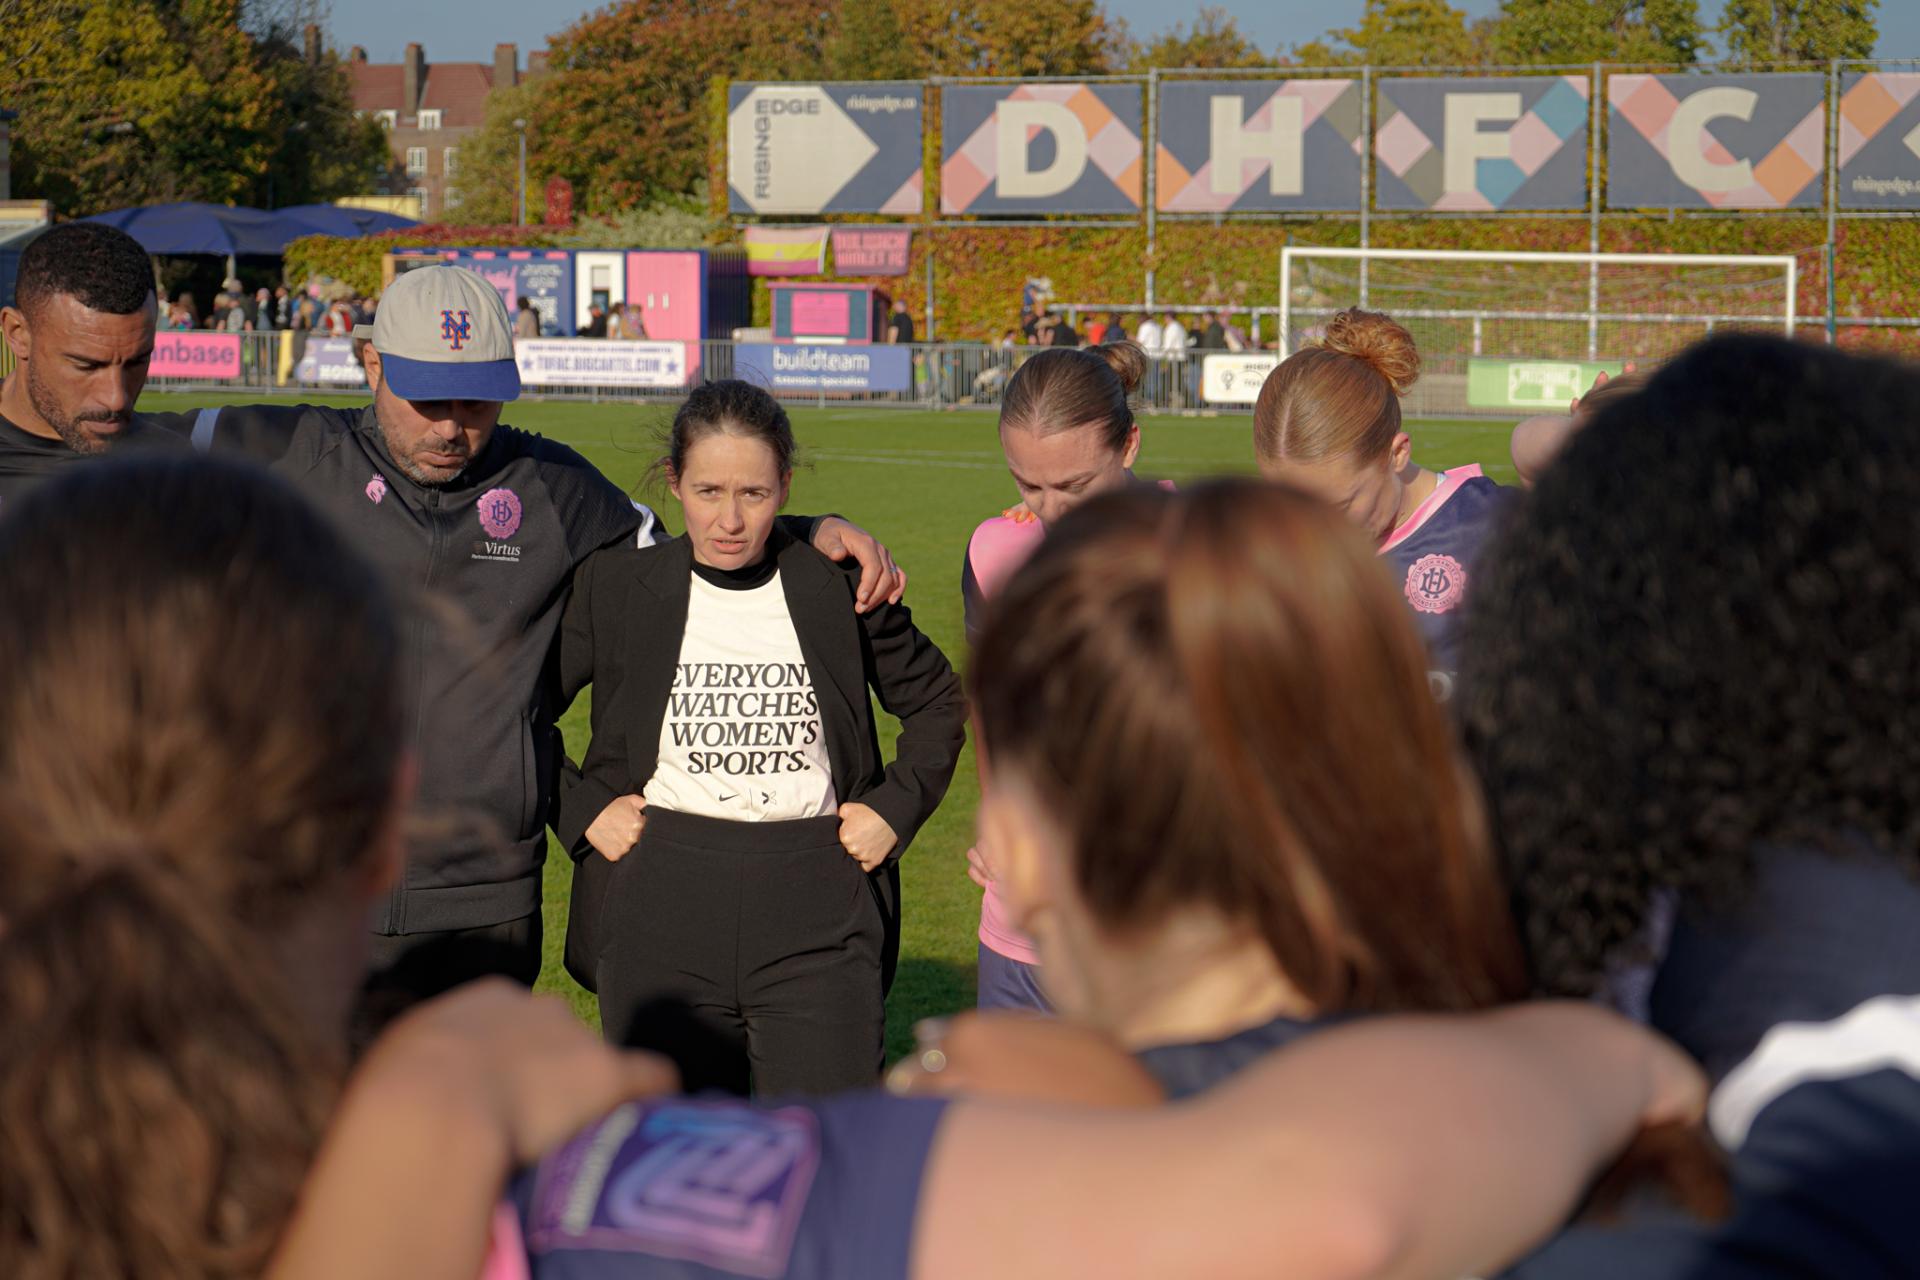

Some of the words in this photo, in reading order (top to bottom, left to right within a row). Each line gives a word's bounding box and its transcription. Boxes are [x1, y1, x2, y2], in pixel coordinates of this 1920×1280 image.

[755, 98, 820, 115] EDGE
[996, 100, 1087, 198] D
[1211, 95, 1303, 195] H
[1444, 93, 1521, 192] F
[1668, 86, 1758, 192] C
[754, 116, 771, 199] RISING
[773, 346, 870, 372] buildteam
[484, 541, 521, 556] Virtus
[670, 691, 818, 718] WATCHES
[670, 720, 819, 747] WOMEN'S
[687, 750, 811, 776] SPORTS.
